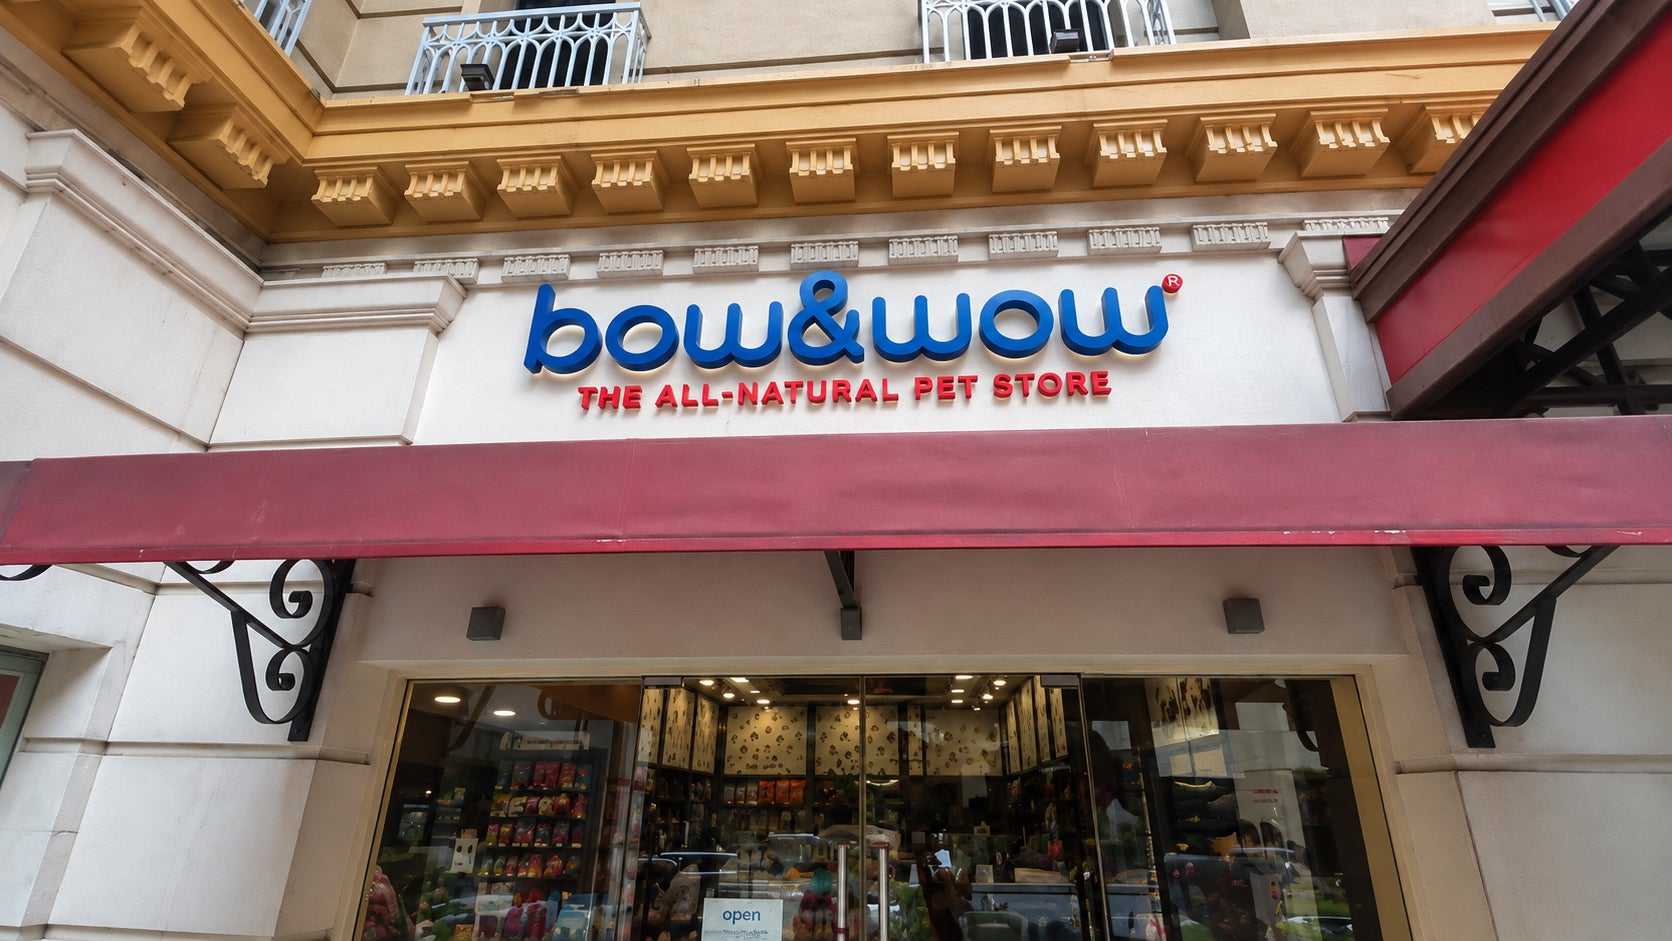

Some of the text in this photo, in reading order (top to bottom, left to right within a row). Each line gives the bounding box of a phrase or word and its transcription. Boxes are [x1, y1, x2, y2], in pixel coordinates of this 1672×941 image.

[578, 370, 1112, 411] THE ALL-NATURAL PET STORE
[722, 910, 761, 925] open
